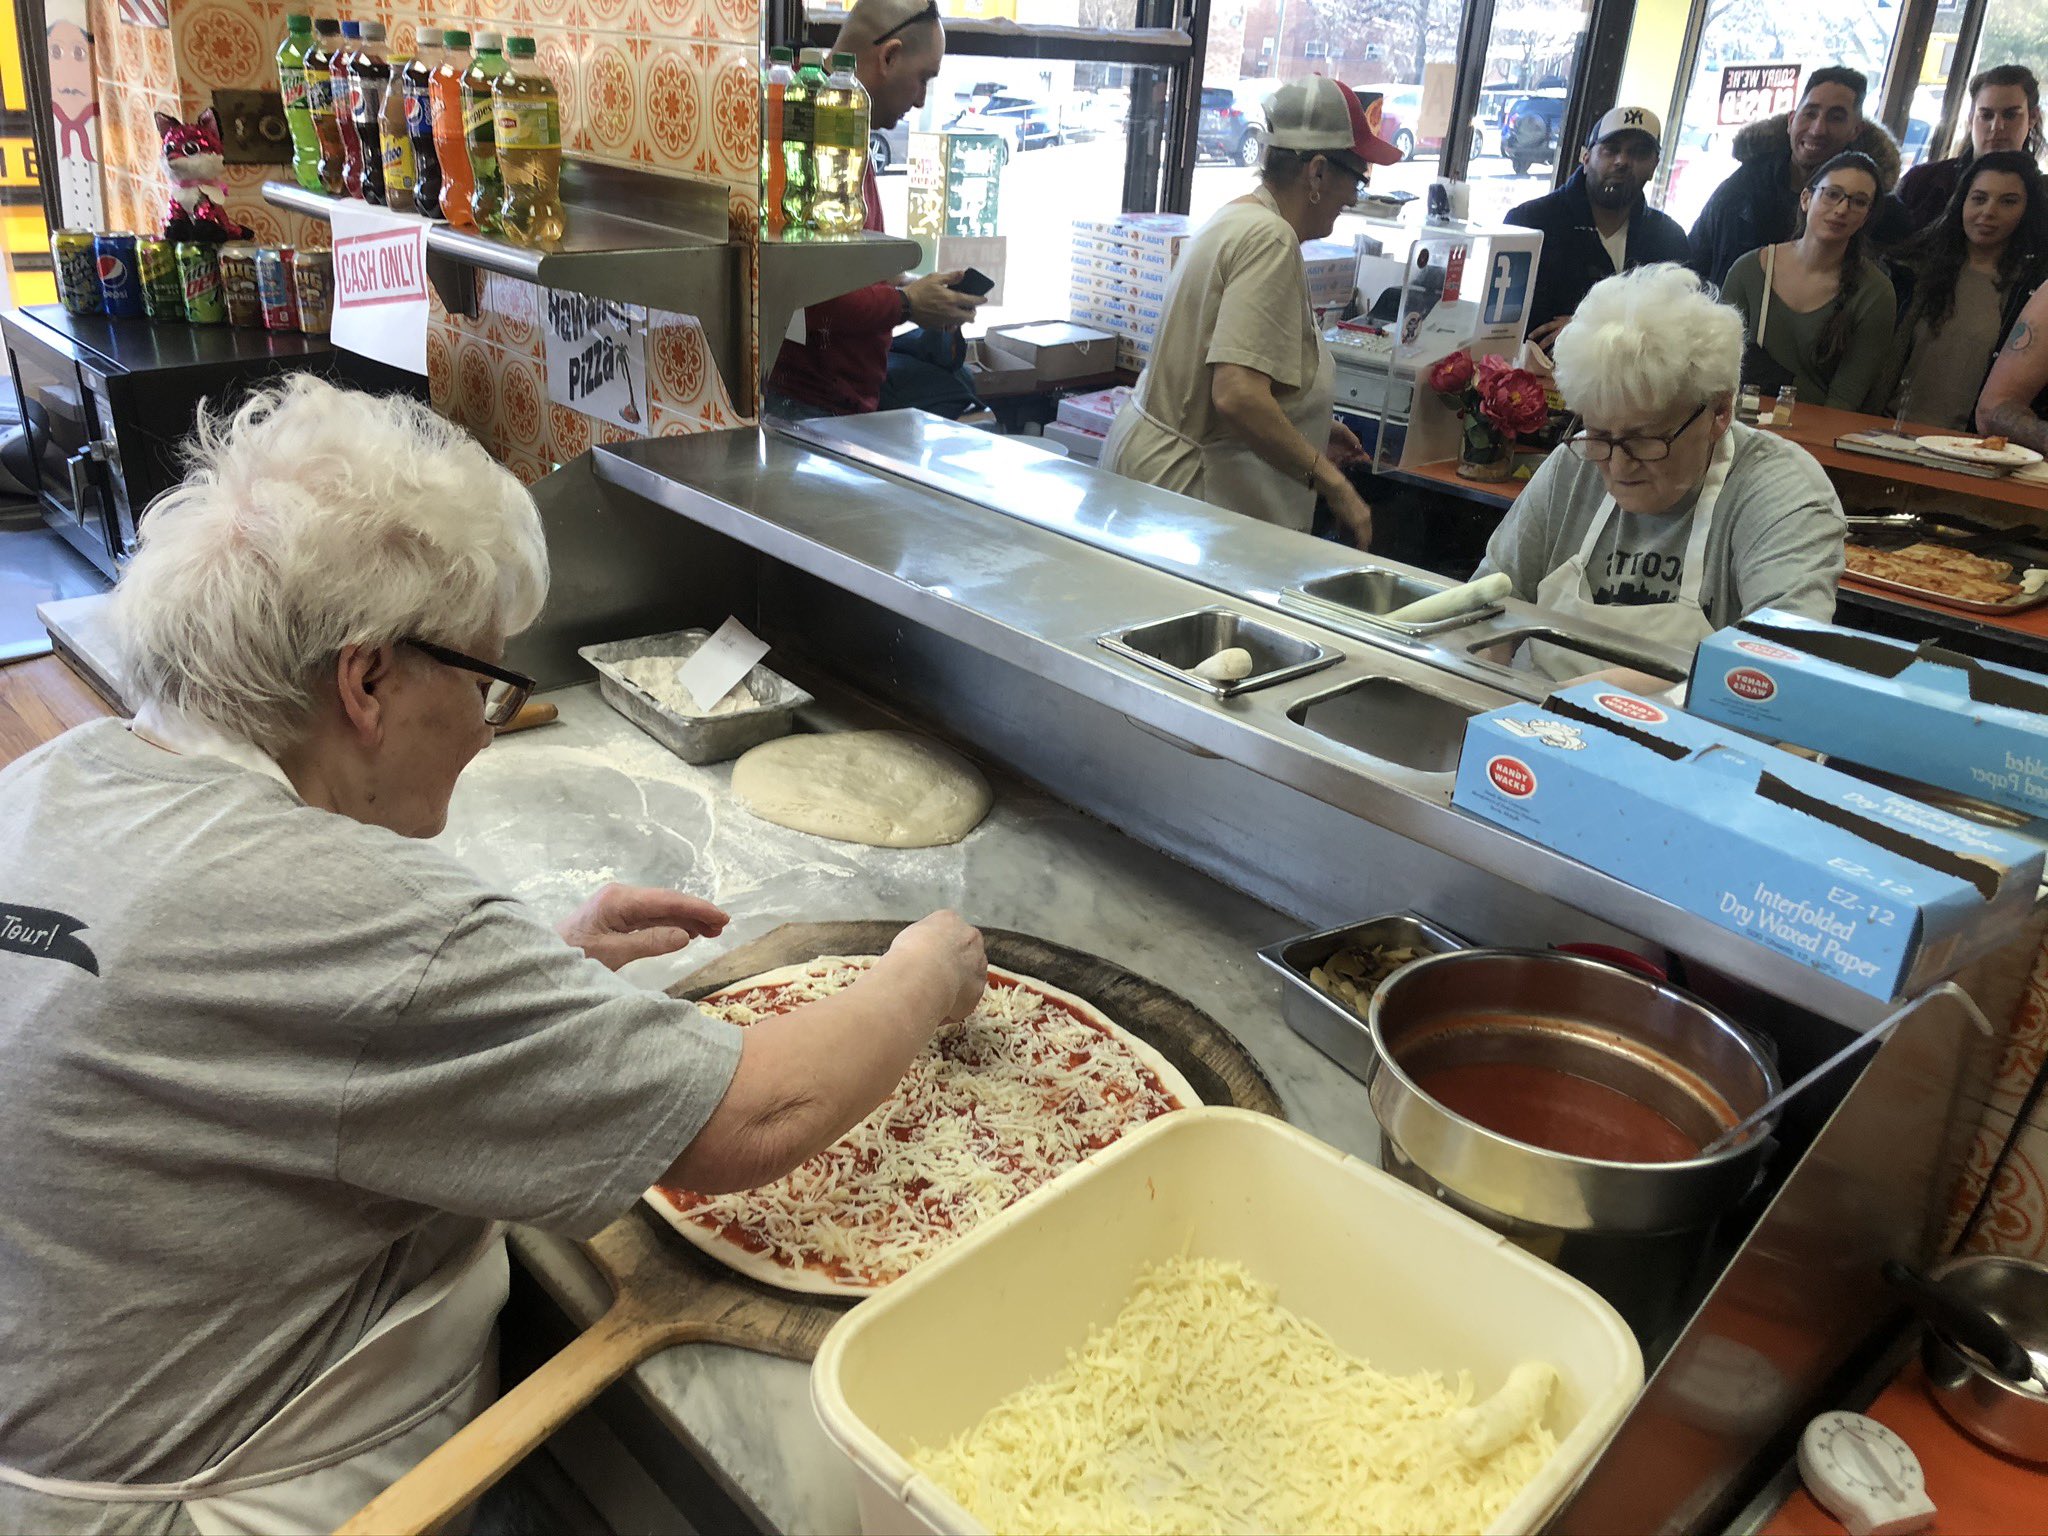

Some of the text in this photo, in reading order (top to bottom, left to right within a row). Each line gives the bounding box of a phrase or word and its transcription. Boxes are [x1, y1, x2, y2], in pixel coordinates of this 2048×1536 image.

[341, 243, 415, 294] CASH ONLY
[1494, 772, 1526, 792] WACKS
[1495, 763, 1528, 782] HANDY
[1827, 857, 1914, 896] EZ-12
[1754, 882, 1857, 942] Interfolded
[1827, 886, 1896, 927] EZ-12
[0, 914, 60, 952] Tour!
[1719, 891, 1755, 927] Dry
[1758, 908, 1823, 952] Waxed
[1824, 938, 1881, 979] Paper
